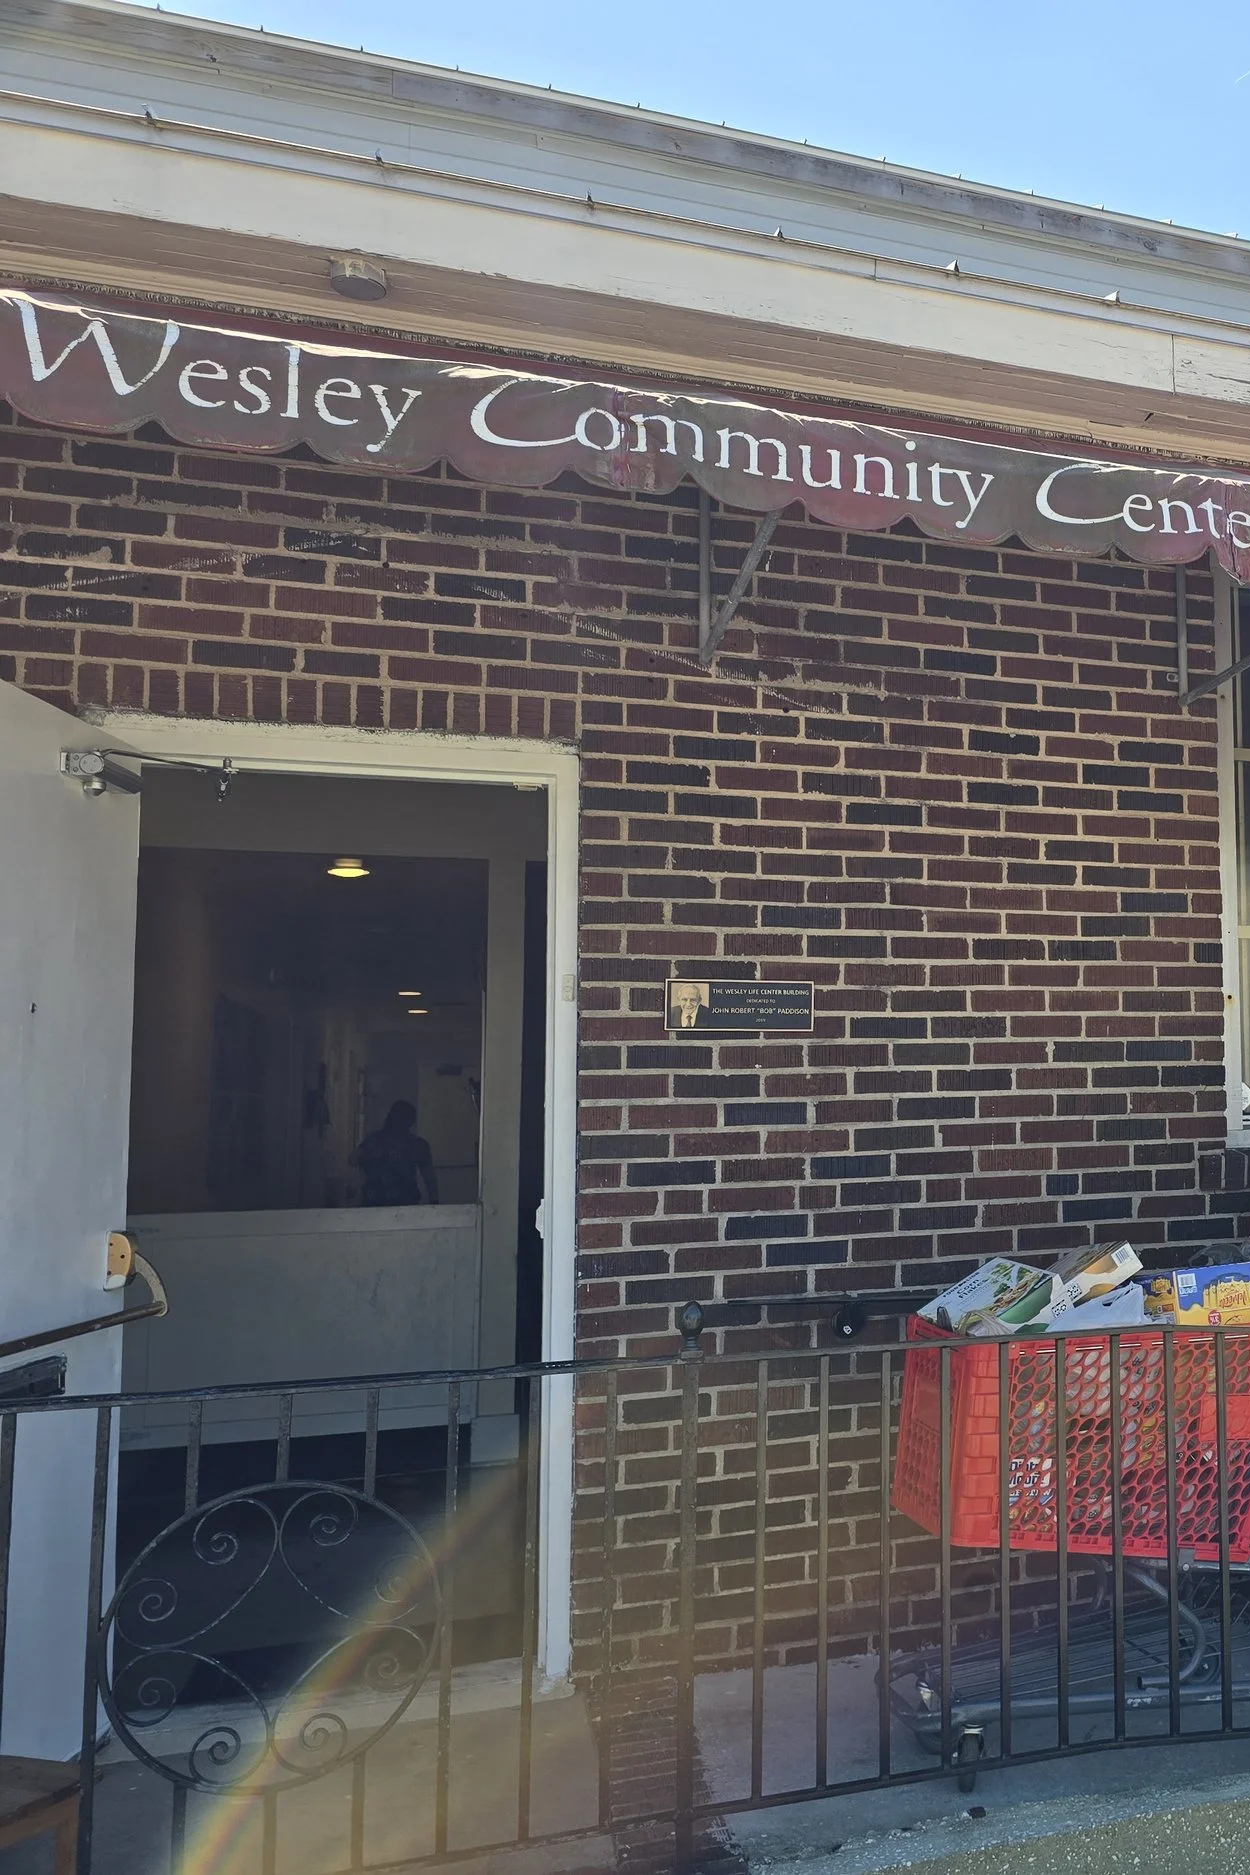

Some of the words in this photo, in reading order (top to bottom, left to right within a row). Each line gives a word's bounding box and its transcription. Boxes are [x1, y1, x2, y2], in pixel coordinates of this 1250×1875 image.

[12, 297, 422, 453] Wesley
[469, 376, 994, 528] Community
[730, 1007, 755, 1015] ROBERT
[956, 1279, 980, 1295] Corn
[958, 1281, 987, 1299] Flakes
